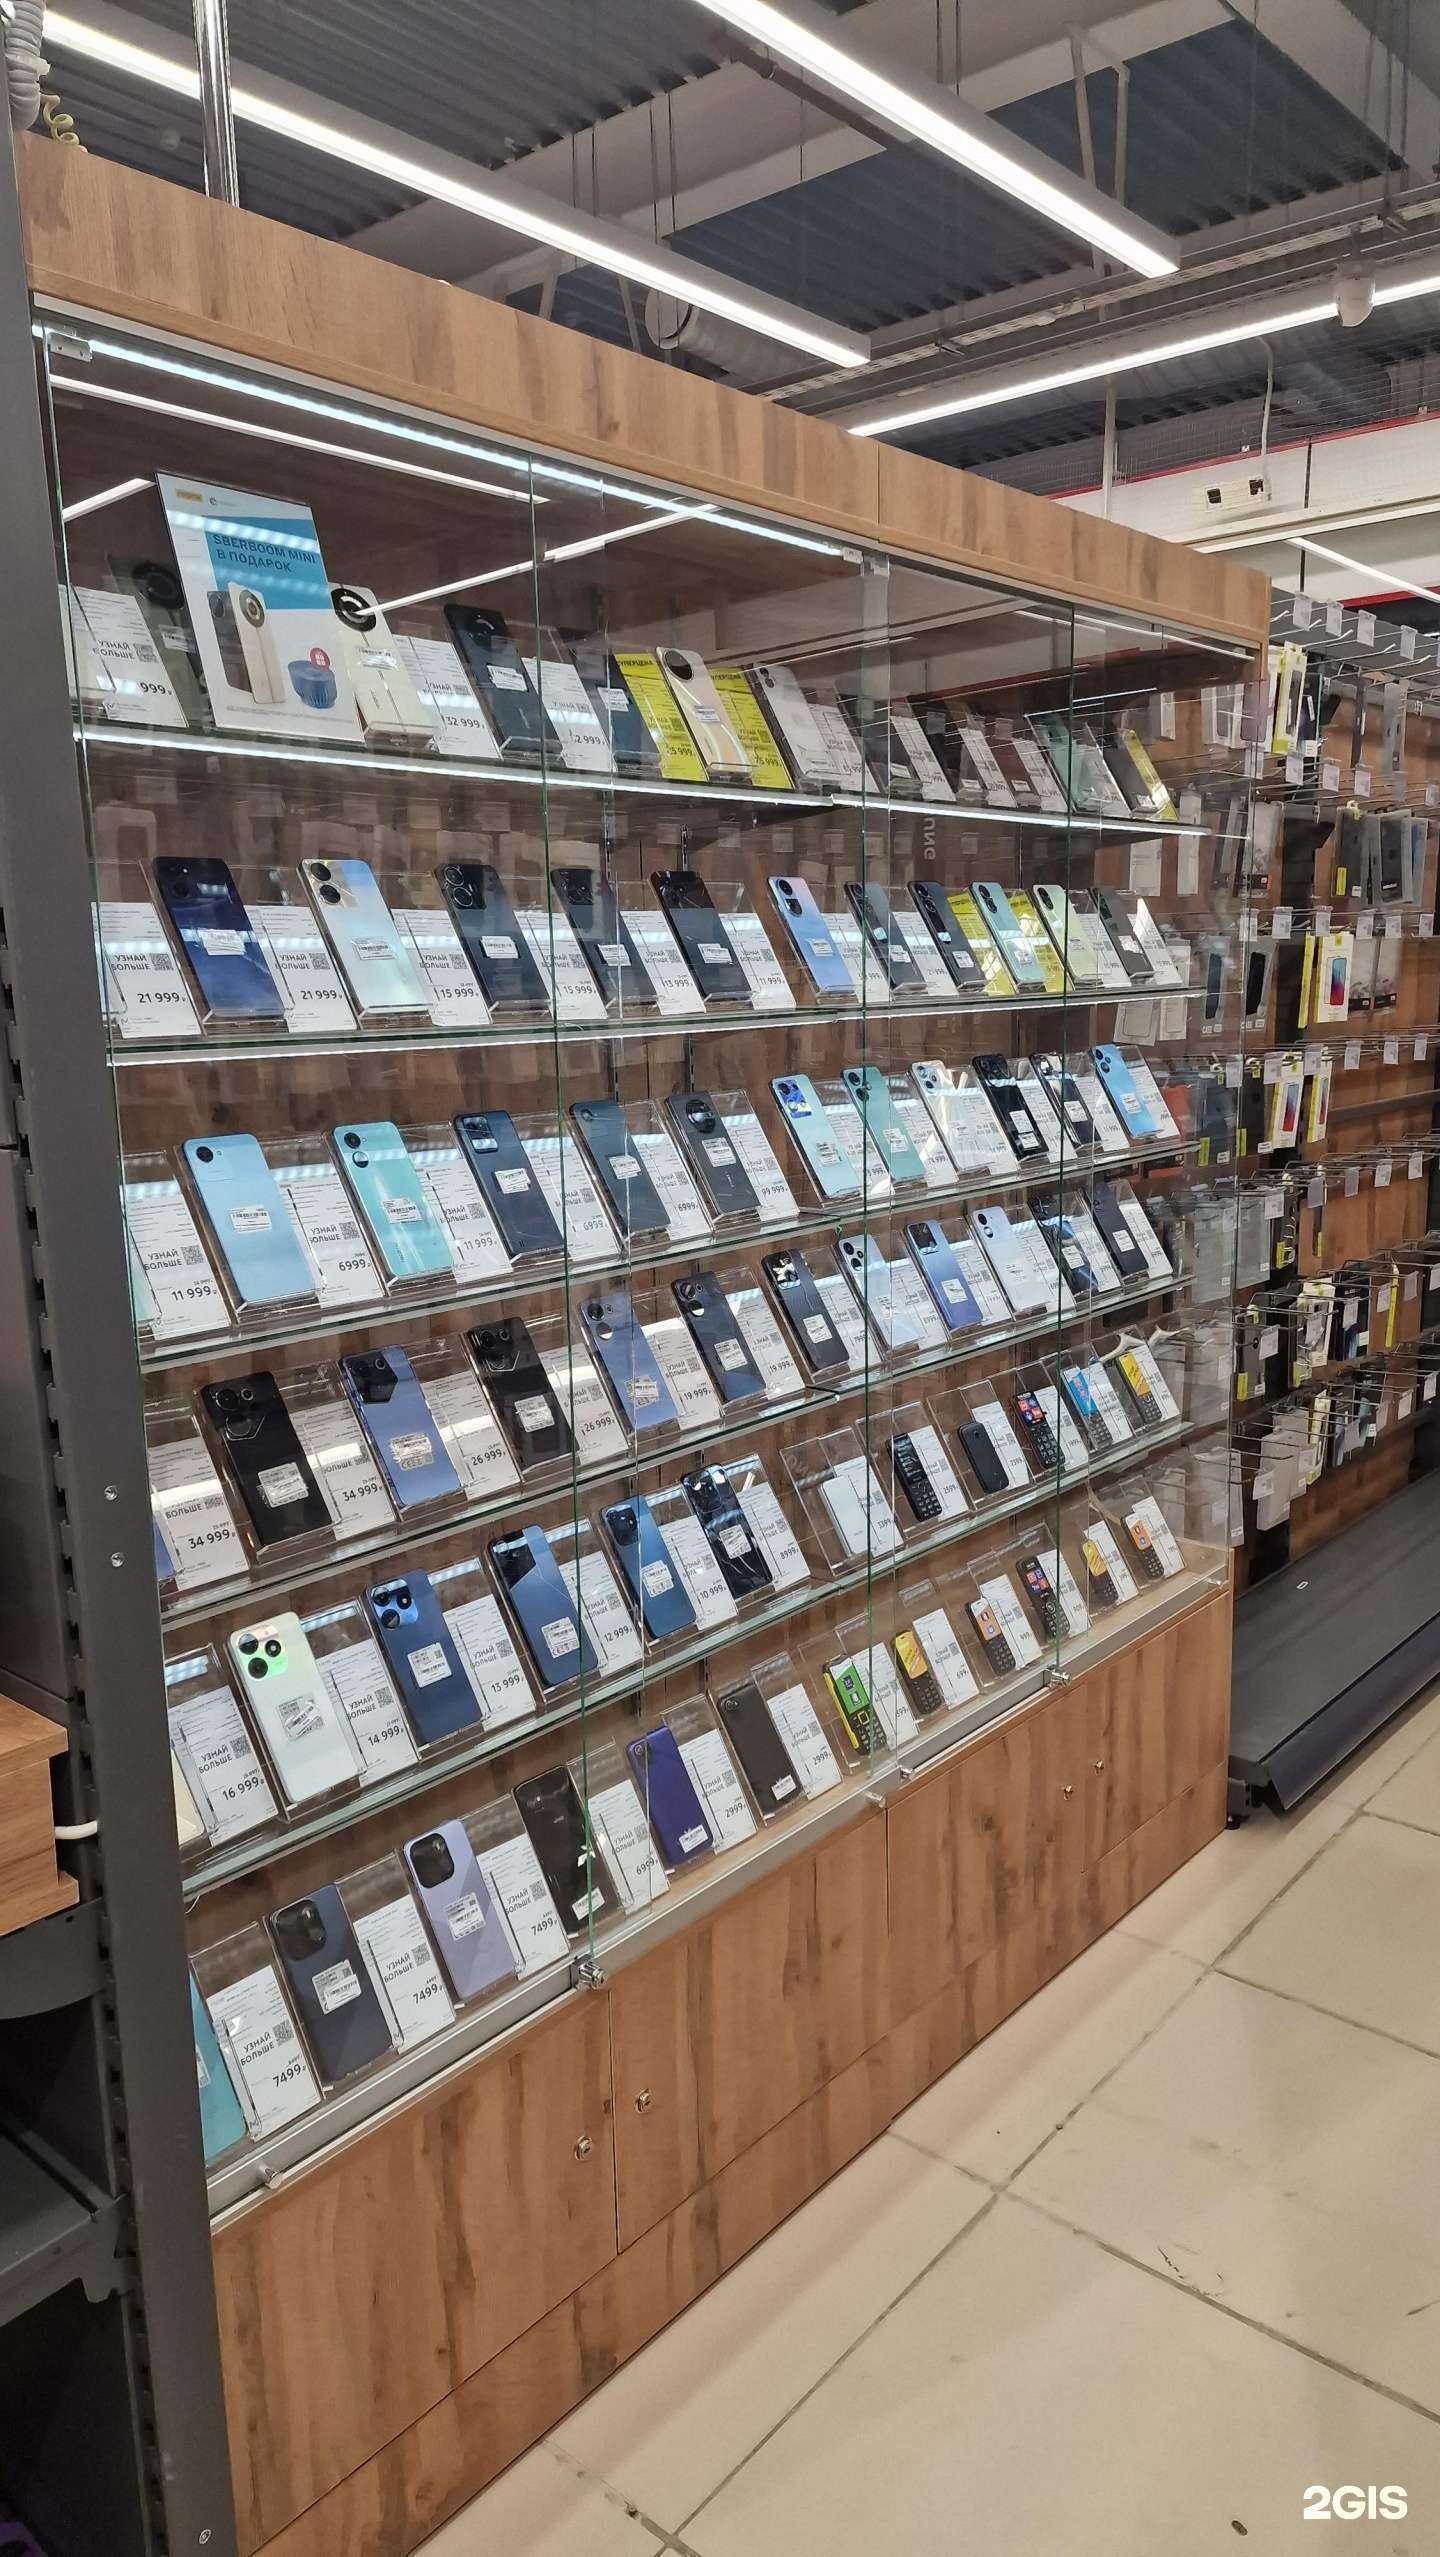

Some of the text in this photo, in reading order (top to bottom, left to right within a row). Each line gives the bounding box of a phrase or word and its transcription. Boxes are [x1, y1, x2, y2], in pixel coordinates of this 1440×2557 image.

[213, 533, 317, 564] SBERBOOM MINI
[218, 550, 292, 573] В ПОДАРОК
[116, 953, 147, 962] УЗНАЙ
[137, 992, 180, 1003] 21 999
[301, 989, 337, 1000] 21 999
[441, 987, 475, 998] 15 999
[310, 1225, 338, 1235] УЗНАЙ
[148, 1249, 180, 1261] УЗНАЙ
[145, 1258, 183, 1271] БОЛЬШЕ
[338, 1258, 367, 1271] 6999
[187, 1285, 212, 1299] 999
[694, 1387, 710, 1397] 999
[471, 1448, 503, 1466] 26 999
[342, 1482, 378, 1502] 34 999
[164, 1503, 203, 1519] БОЛЬШЕ
[187, 1528, 230, 1549] 34 999
[604, 1625, 631, 1643] 12 999
[503, 1673, 520, 1688] 999
[349, 1695, 375, 1711] УЗНАЙ
[367, 1725, 401, 1747] 14 999
[200, 1743, 230, 1762] УЗНАЙ
[198, 1753, 234, 1774] БОЛЬШЕ
[222, 1775, 260, 1801] 16 999
[725, 1801, 744, 1819] 2999
[635, 1857, 656, 1876] 6999
[507, 1887, 529, 1905] УЗНАЙ
[530, 1917, 555, 1936] 7499
[385, 1950, 411, 1970] УЗНАЙ
[383, 1961, 415, 1984] БОЛЬШЕ
[412, 1983, 438, 2005] 7499
[243, 2032, 273, 2053] УЗНАЙ
[239, 2042, 276, 2067] БОЛЬШЕ
[272, 2063, 302, 2089] 7499
